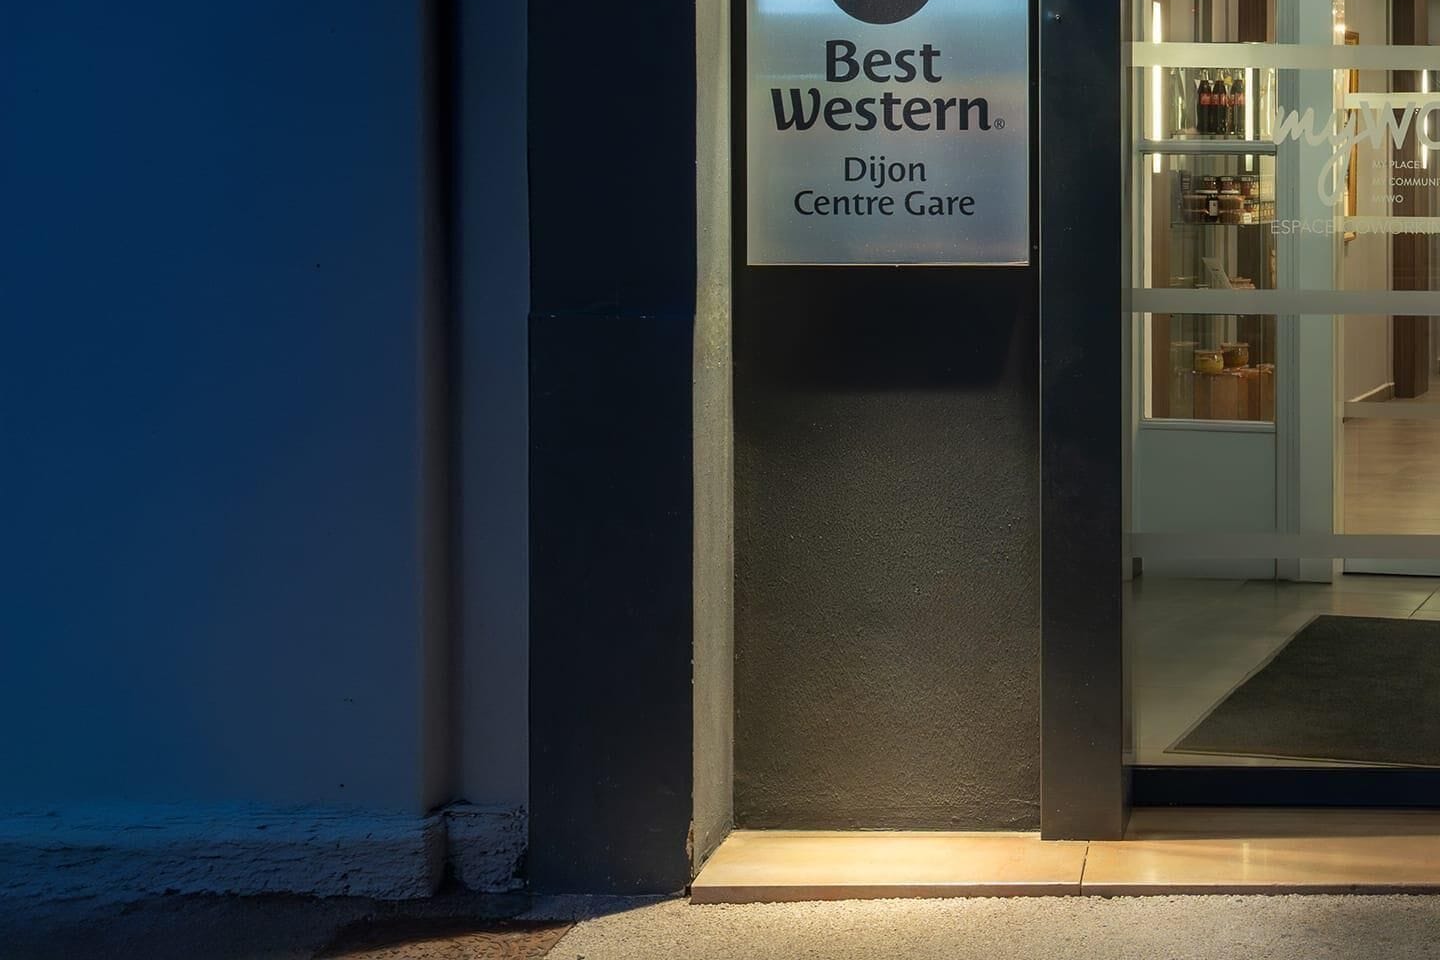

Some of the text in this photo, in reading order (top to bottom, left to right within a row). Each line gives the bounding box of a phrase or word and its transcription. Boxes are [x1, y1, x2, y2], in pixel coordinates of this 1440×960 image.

[825, 40, 942, 83] Best
[844, 156, 927, 188] Dijon
[1372, 160, 1386, 169] MY
[793, 191, 975, 216] Centre Gare
[1270, 219, 1334, 235] ESPACE
